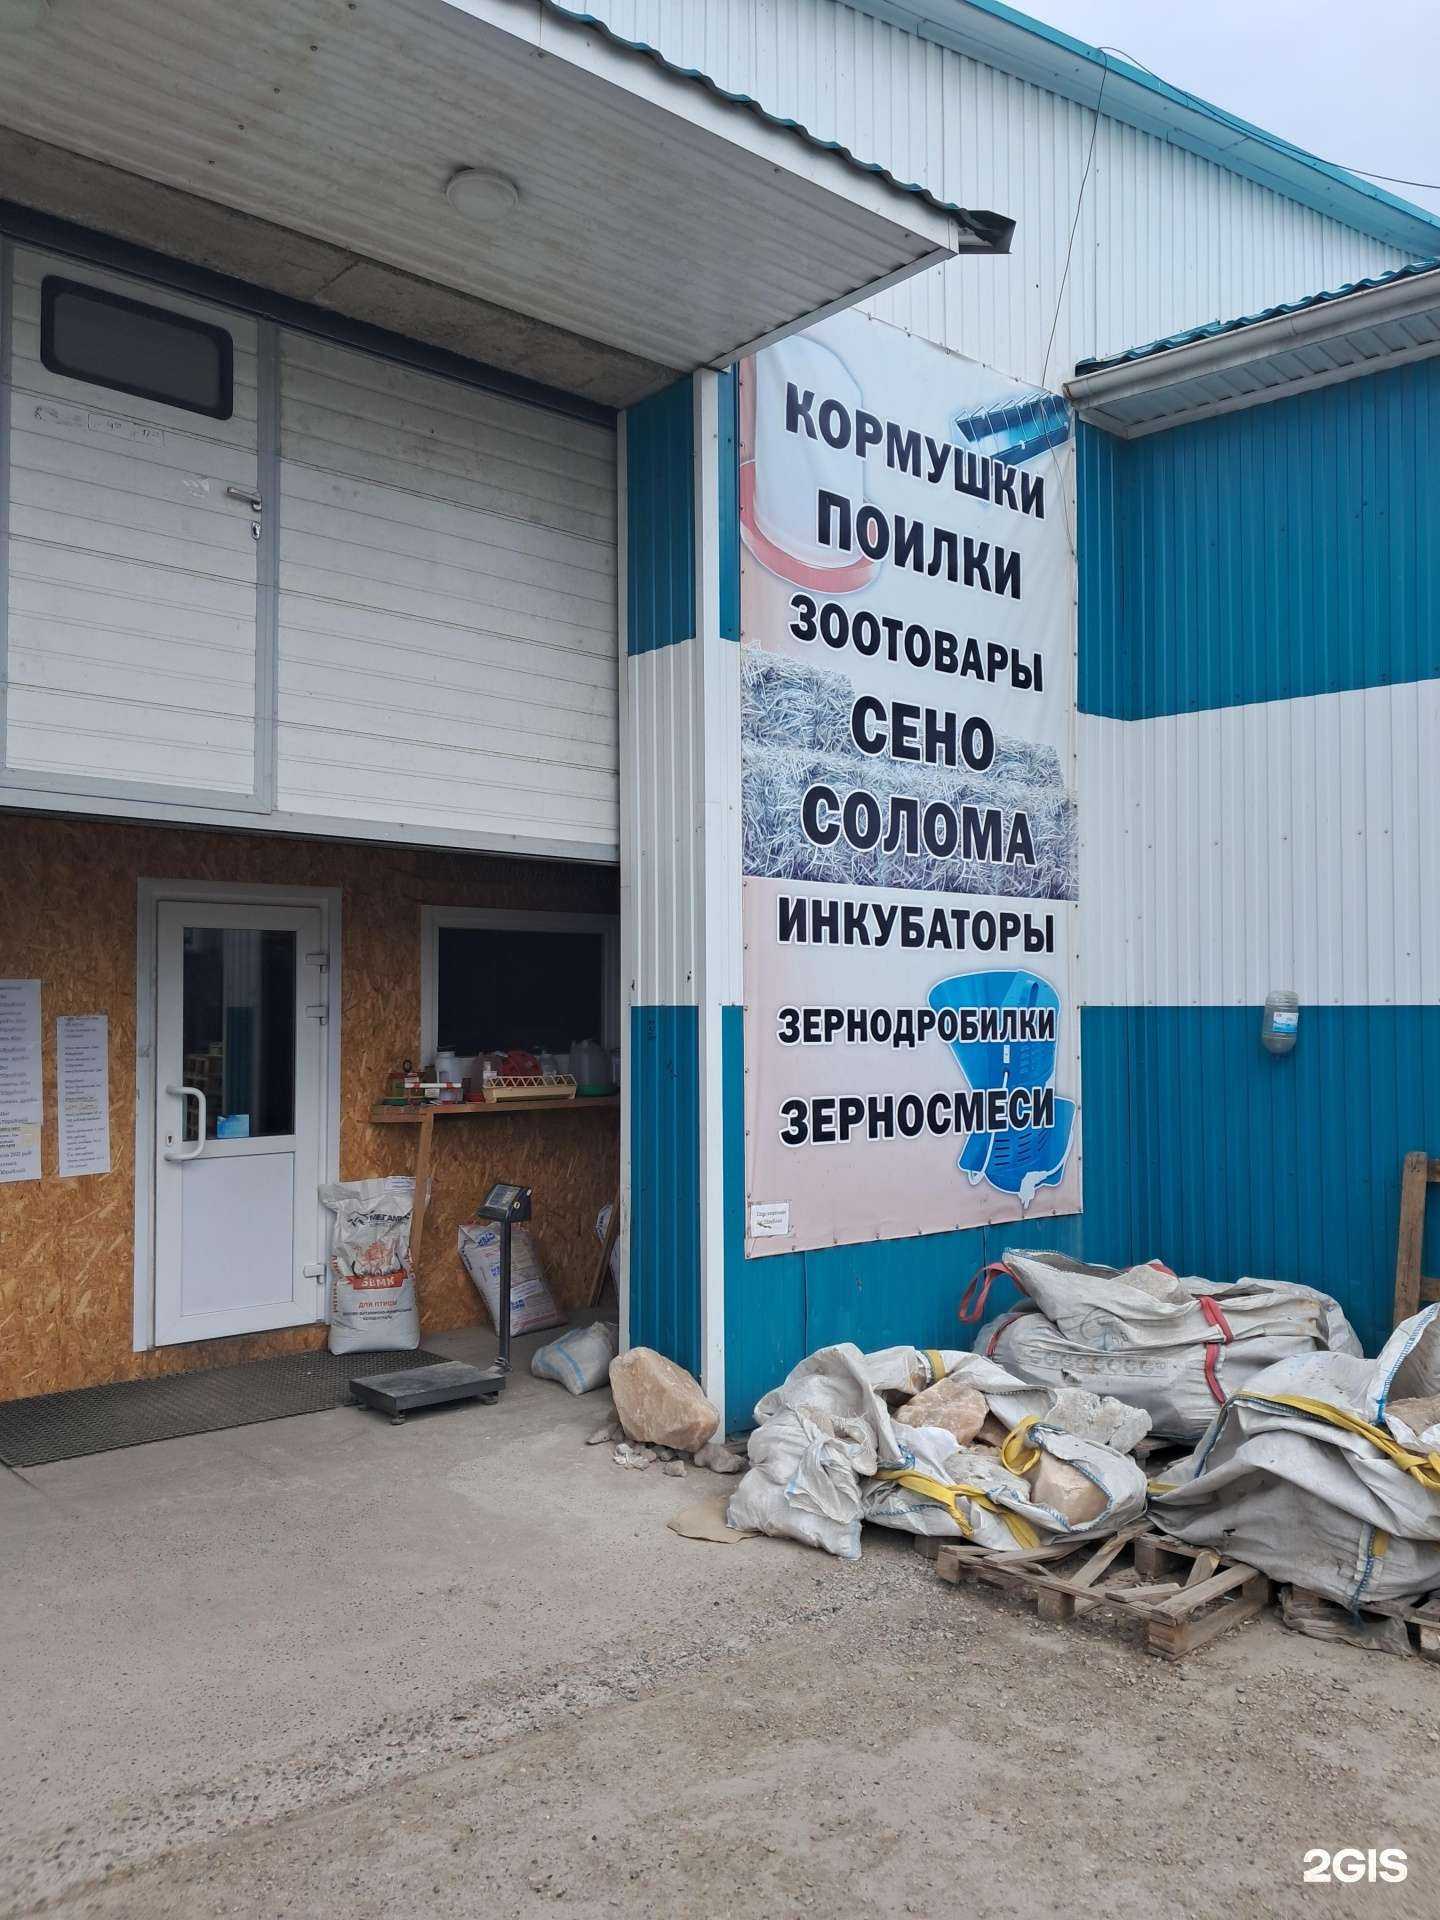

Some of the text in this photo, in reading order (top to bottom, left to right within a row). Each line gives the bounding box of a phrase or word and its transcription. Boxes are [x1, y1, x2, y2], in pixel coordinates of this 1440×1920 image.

[786, 382, 1046, 520] КОРМУШКИ
[818, 488, 1021, 600] ПОИЛКИ
[790, 594, 1043, 692] ЗООТОВАРЫ
[851, 695, 994, 771] СЕНО
[802, 785, 1035, 865] СОЛОМА
[779, 897, 1054, 953] ИНКУБАТОРЫ
[778, 1008, 1055, 1048] ЗЕРНОДРОБИЛКИ
[780, 1088, 1053, 1145] ЗЕРНОСМЕСИ
